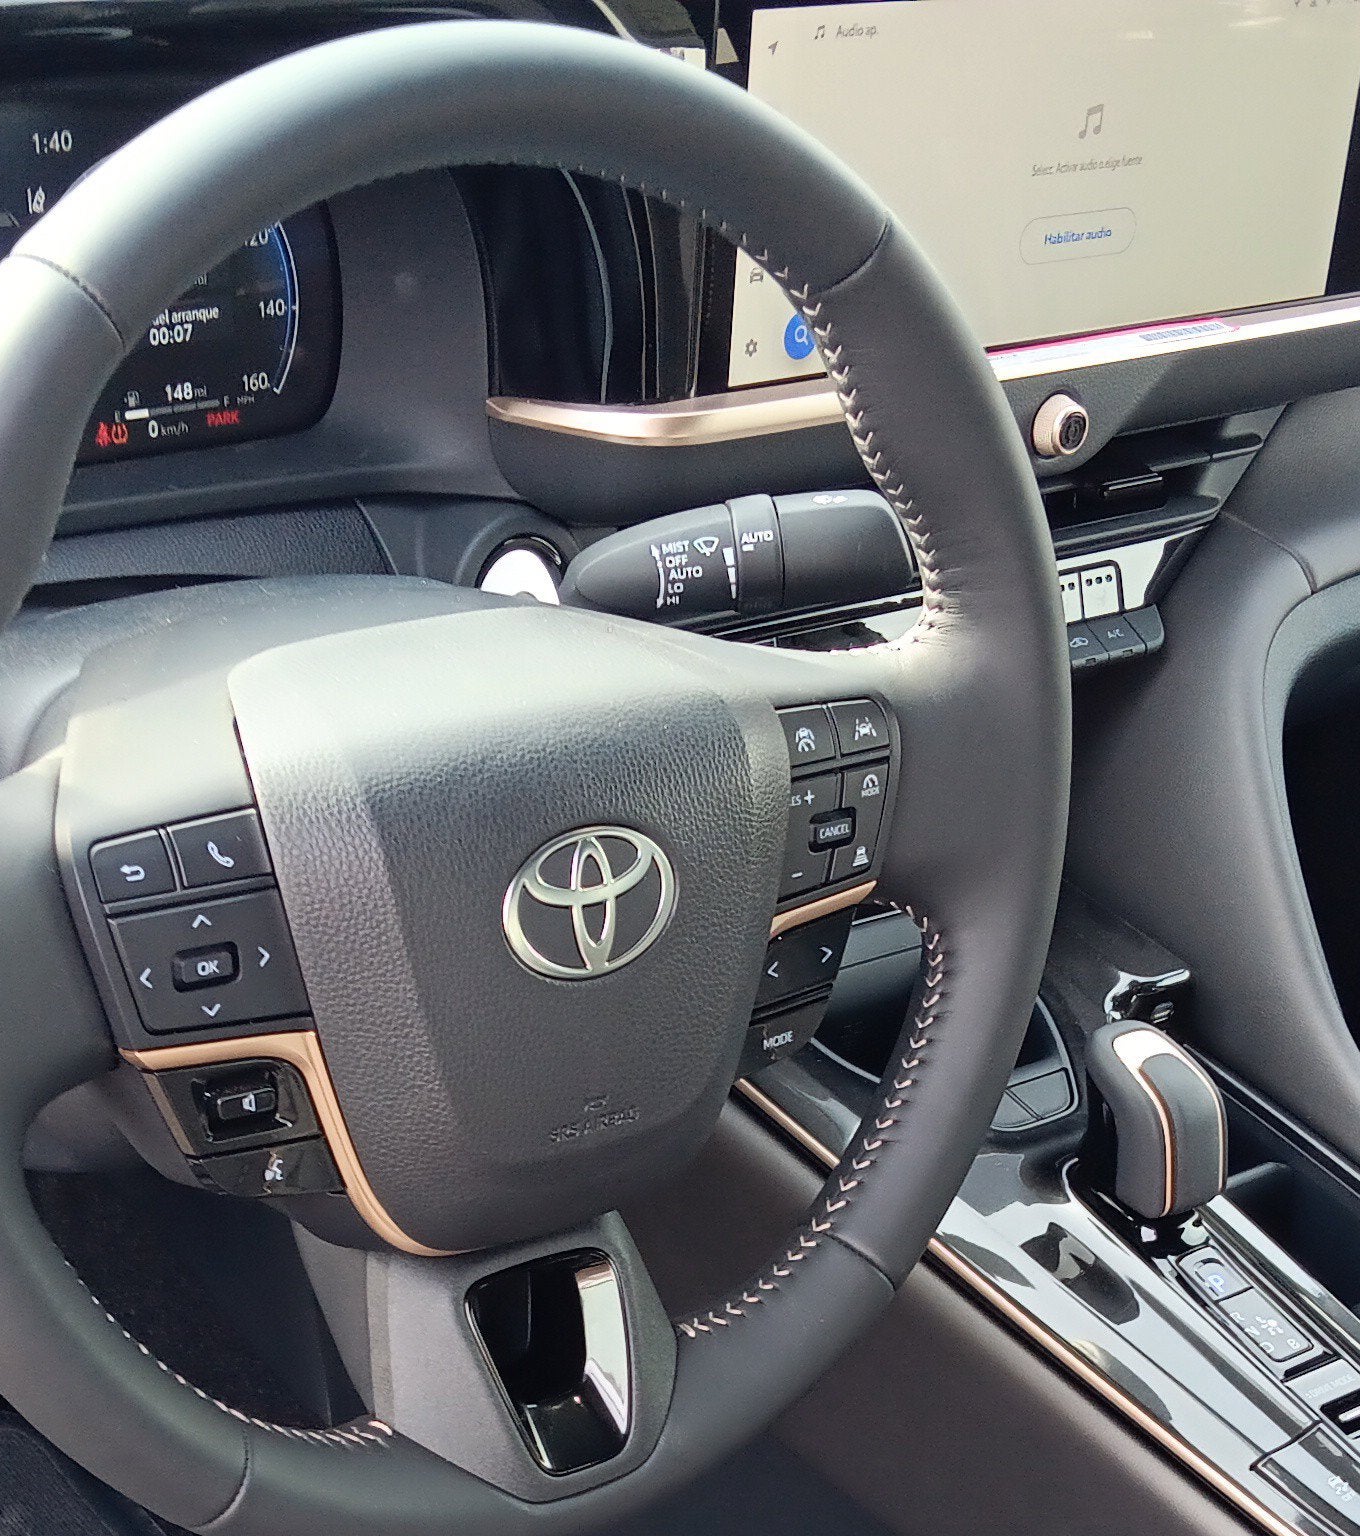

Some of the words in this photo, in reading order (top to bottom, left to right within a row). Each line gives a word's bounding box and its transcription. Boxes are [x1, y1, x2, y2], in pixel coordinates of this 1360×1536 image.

[31, 129, 73, 154] 1:40
[244, 230, 269, 247] 20
[1044, 230, 1084, 246] Habilitar
[1085, 227, 1113, 240] audio
[258, 298, 285, 318] 140
[148, 323, 193, 347] 00:07
[242, 371, 269, 392] 160
[206, 410, 240, 426] PARK
[148, 420, 159, 438] 0
[741, 529, 774, 544] AUTO
[661, 540, 690, 555] MIST
[665, 554, 688, 568] OFF
[669, 565, 703, 580] AUTO
[667, 582, 684, 594] LO
[666, 595, 680, 606] HI
[819, 823, 850, 840] CANCEL
[196, 959, 220, 976] OK
[763, 1030, 794, 1051] MODE
[1209, 1274, 1226, 1293] P
